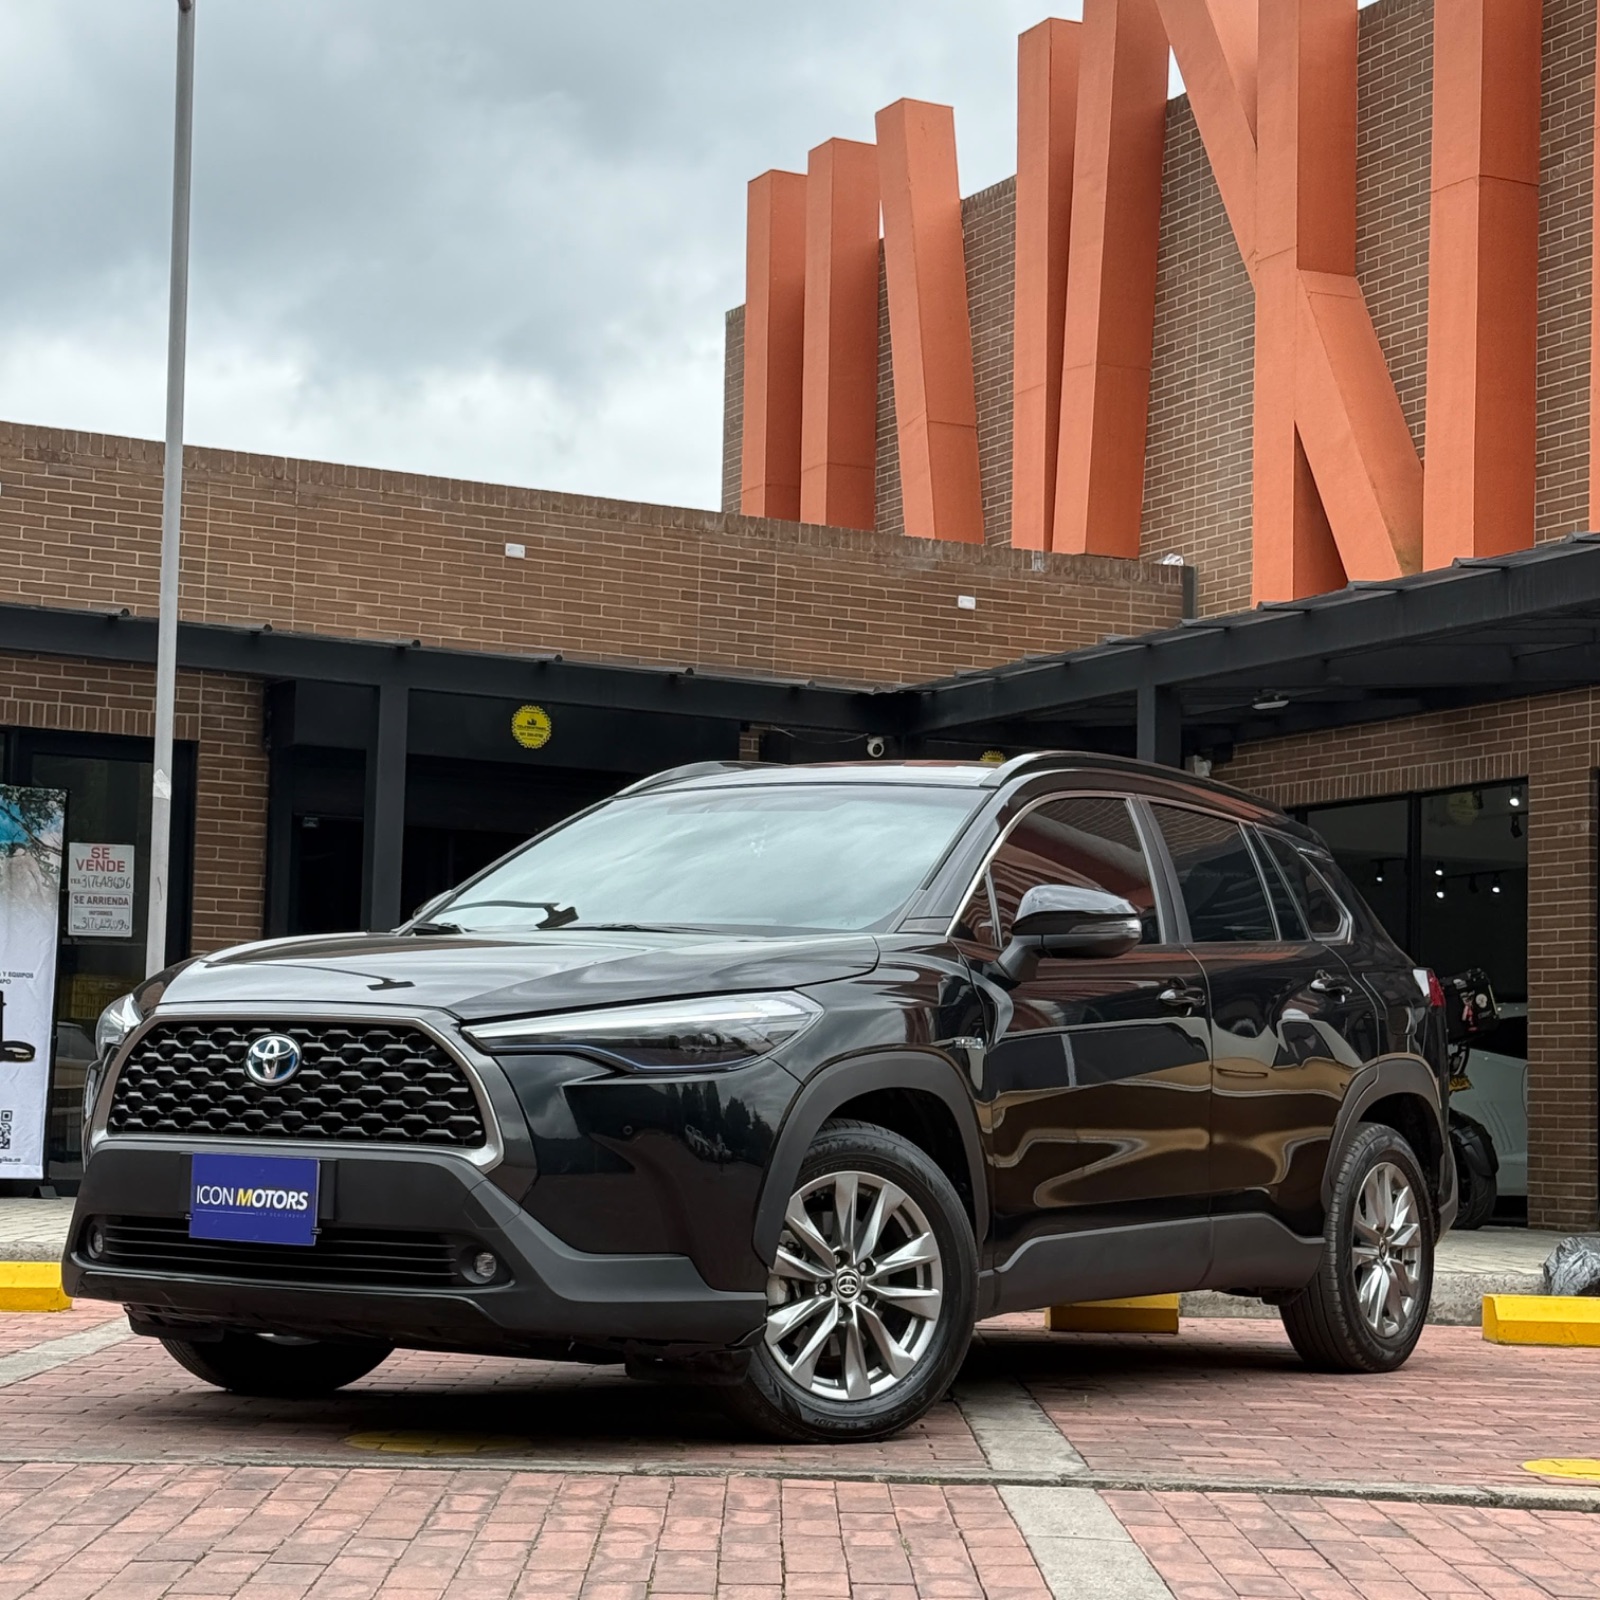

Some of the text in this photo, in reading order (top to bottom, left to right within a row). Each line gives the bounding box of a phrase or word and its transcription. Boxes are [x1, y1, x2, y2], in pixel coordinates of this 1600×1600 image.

[91, 847, 110, 859] SE
[75, 859, 125, 872] VENDE
[73, 895, 129, 906] SE ARRIENDA
[196, 1185, 309, 1211] ICON MOTORS
